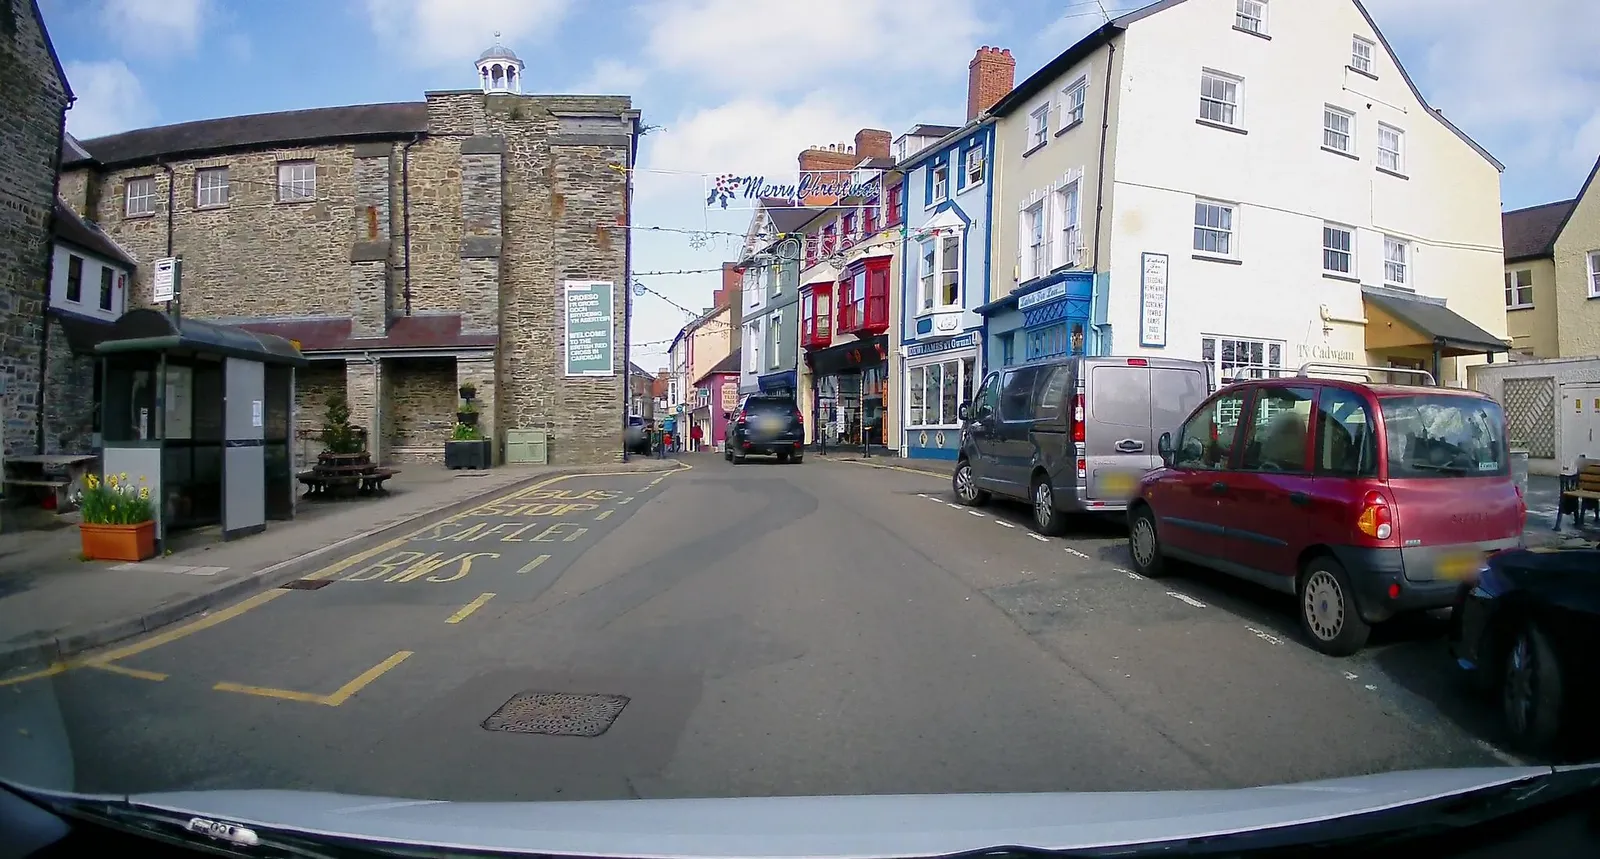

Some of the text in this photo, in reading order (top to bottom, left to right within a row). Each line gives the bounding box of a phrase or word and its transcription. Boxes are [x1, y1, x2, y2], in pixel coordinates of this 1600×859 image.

[742, 172, 881, 205] Merry Christmas
[924, 341, 944, 354] JAMES
[1312, 345, 1354, 362] Cadwgan
[571, 354, 603, 362] CARDIGAN
[517, 489, 624, 501] BUS
[469, 503, 600, 517] STOP
[411, 522, 580, 542] SAFLE
[338, 551, 501, 583] BWS
